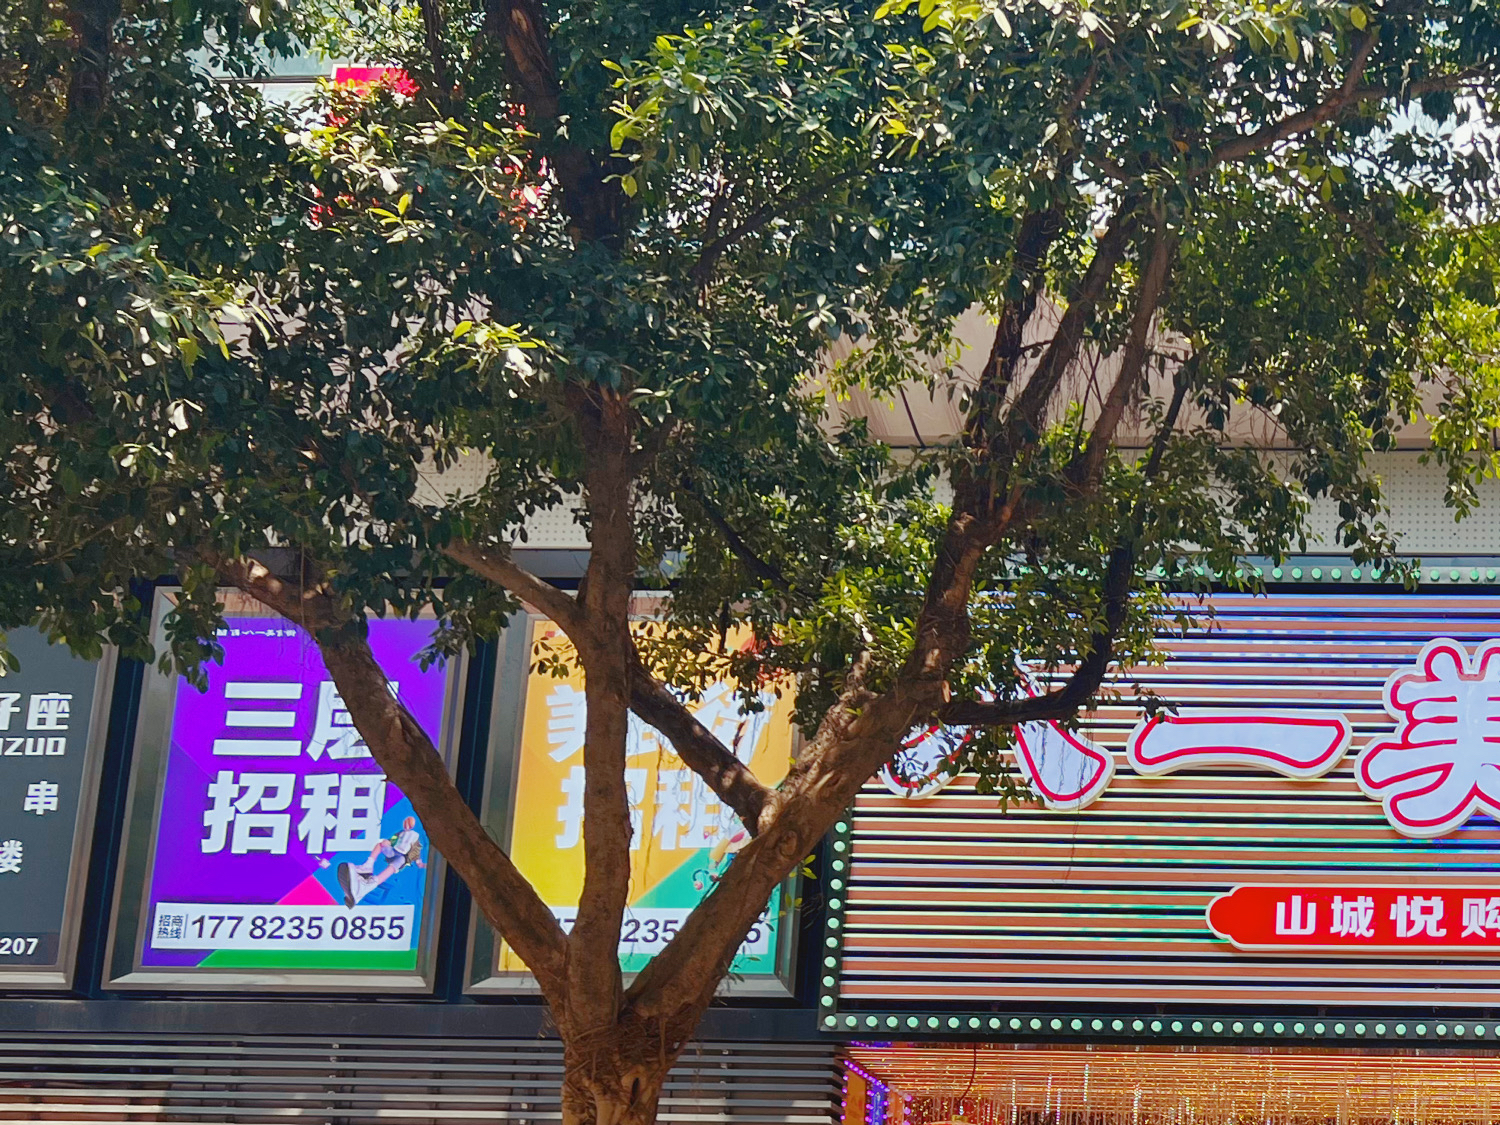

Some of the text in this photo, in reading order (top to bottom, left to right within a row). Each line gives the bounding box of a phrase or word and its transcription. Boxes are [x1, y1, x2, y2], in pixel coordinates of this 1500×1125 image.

[201, 770, 388, 855] 招租
[192, 915, 406, 940] 177 8235 0855
